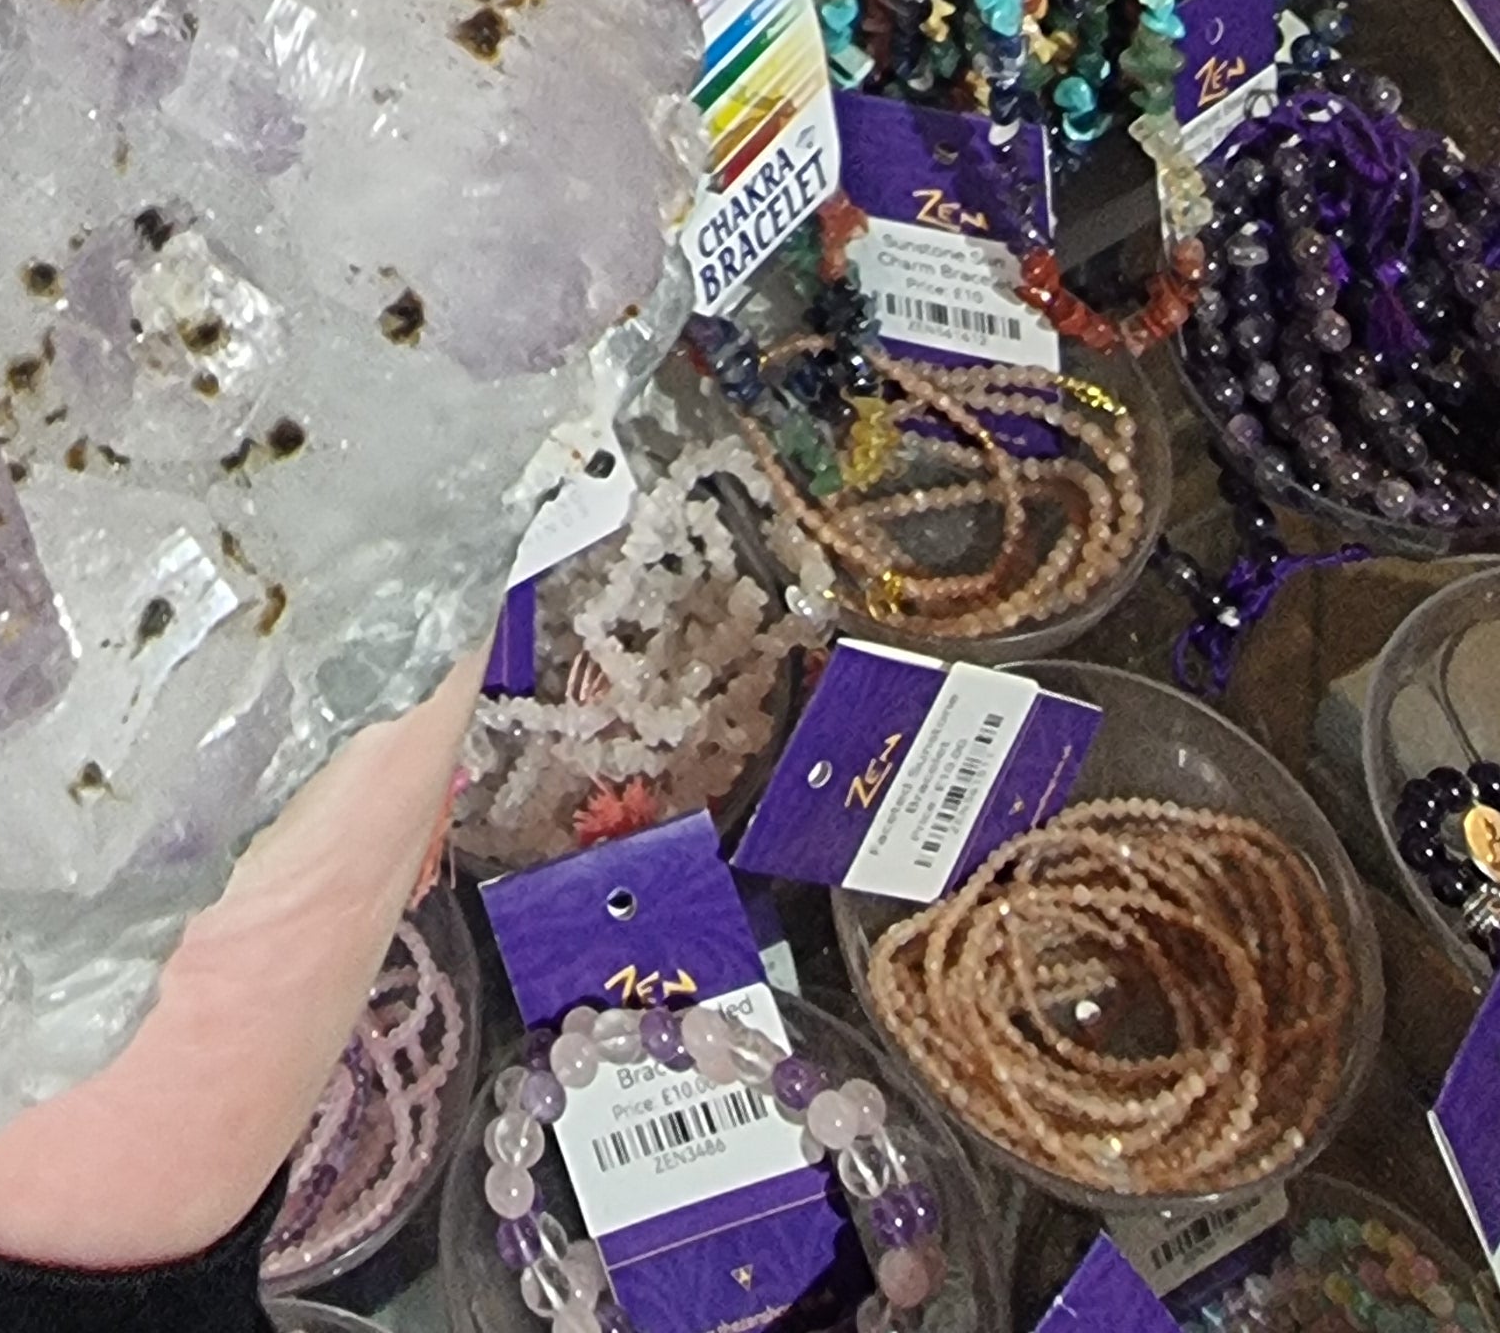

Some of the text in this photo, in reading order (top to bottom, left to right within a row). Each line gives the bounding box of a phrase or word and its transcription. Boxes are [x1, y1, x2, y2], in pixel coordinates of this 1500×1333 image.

[1194, 55, 1245, 108] ZEN
[698, 148, 796, 258] CHAKRA
[699, 152, 829, 303] BRACELET
[912, 190, 989, 233] ZEN
[844, 732, 902, 809] ZEN
[905, 741, 950, 814] Bracelet
[604, 964, 698, 1007] ZEN
[653, 1137, 727, 1174] ZEN3486
